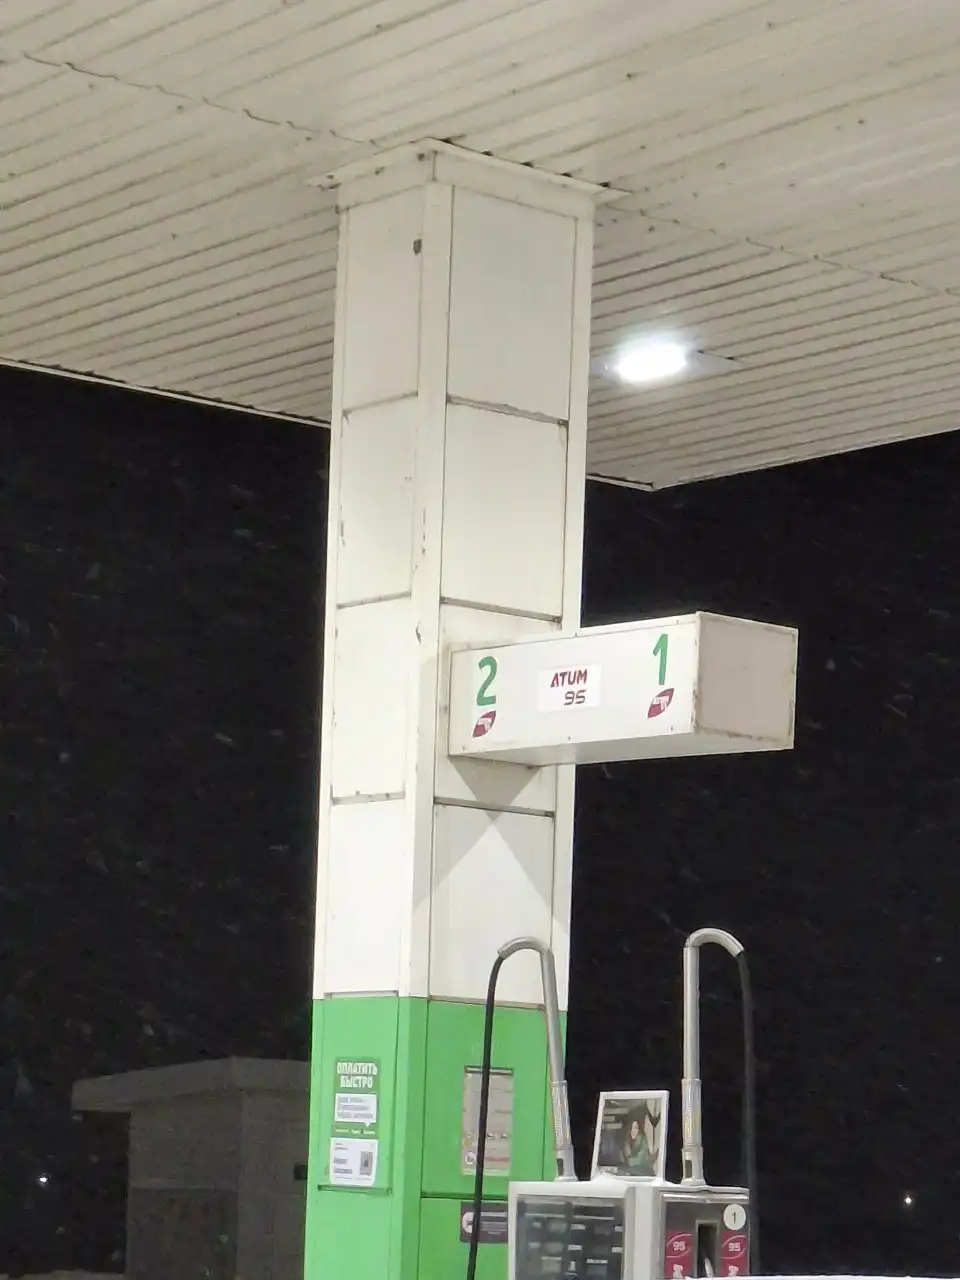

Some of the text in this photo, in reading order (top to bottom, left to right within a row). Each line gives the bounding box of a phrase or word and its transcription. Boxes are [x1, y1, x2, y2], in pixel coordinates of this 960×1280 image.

[652, 633, 669, 686] 1
[476, 655, 498, 707] 2
[550, 668, 588, 688] ATUM
[563, 689, 587, 706] 95
[340, 1075, 373, 1088] БЫСТРО
[731, 1211, 738, 1225] 1
[672, 1241, 686, 1251] 95
[728, 1242, 741, 1252] 95
